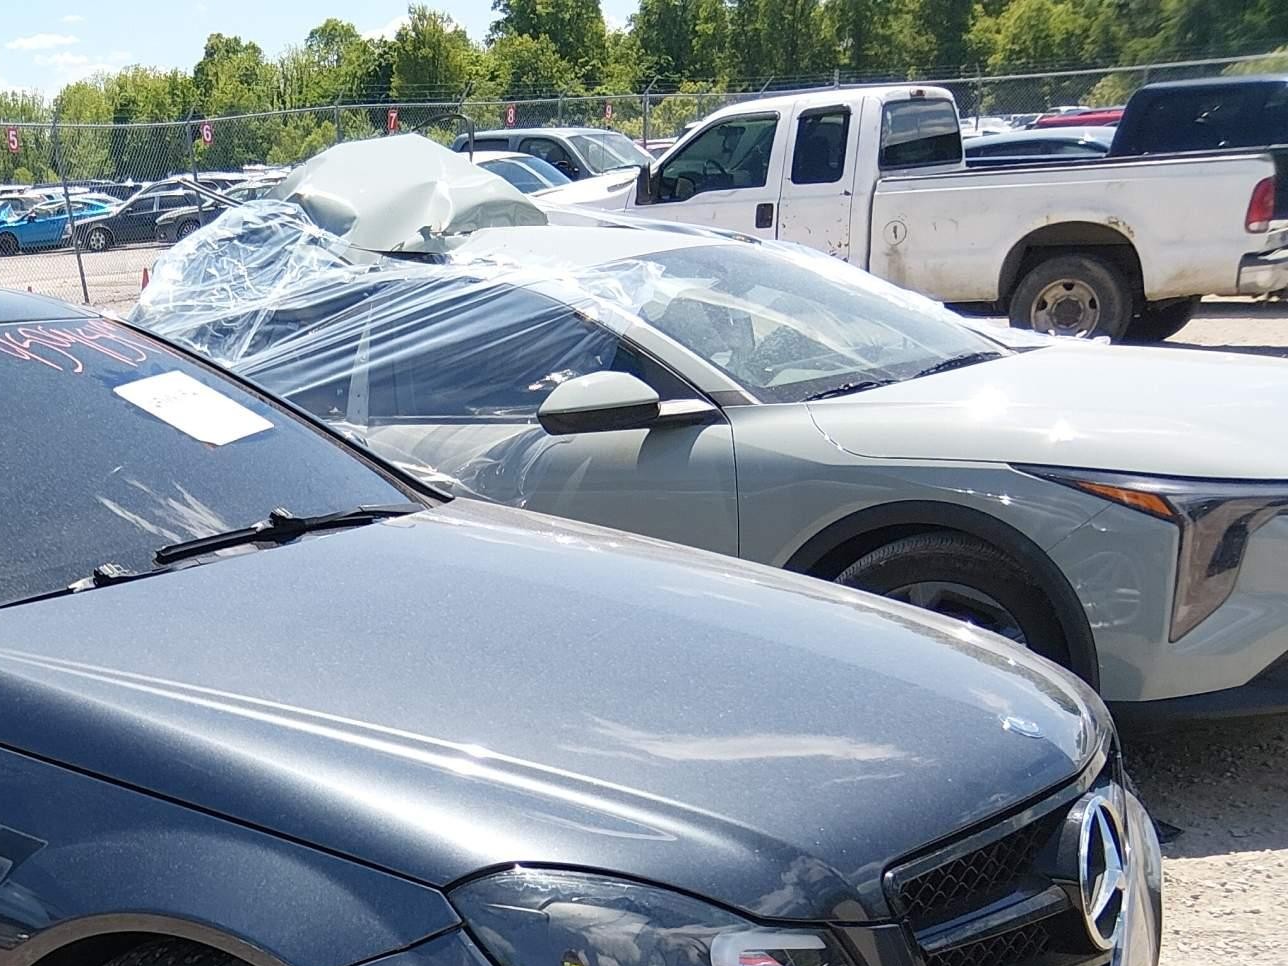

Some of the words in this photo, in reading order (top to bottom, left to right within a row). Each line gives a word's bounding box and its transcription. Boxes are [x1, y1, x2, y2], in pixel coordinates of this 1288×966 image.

[390, 112, 397, 129] 7
[507, 108, 513, 124] 8
[9, 130, 18, 149] 5
[203, 124, 211, 142] 6
